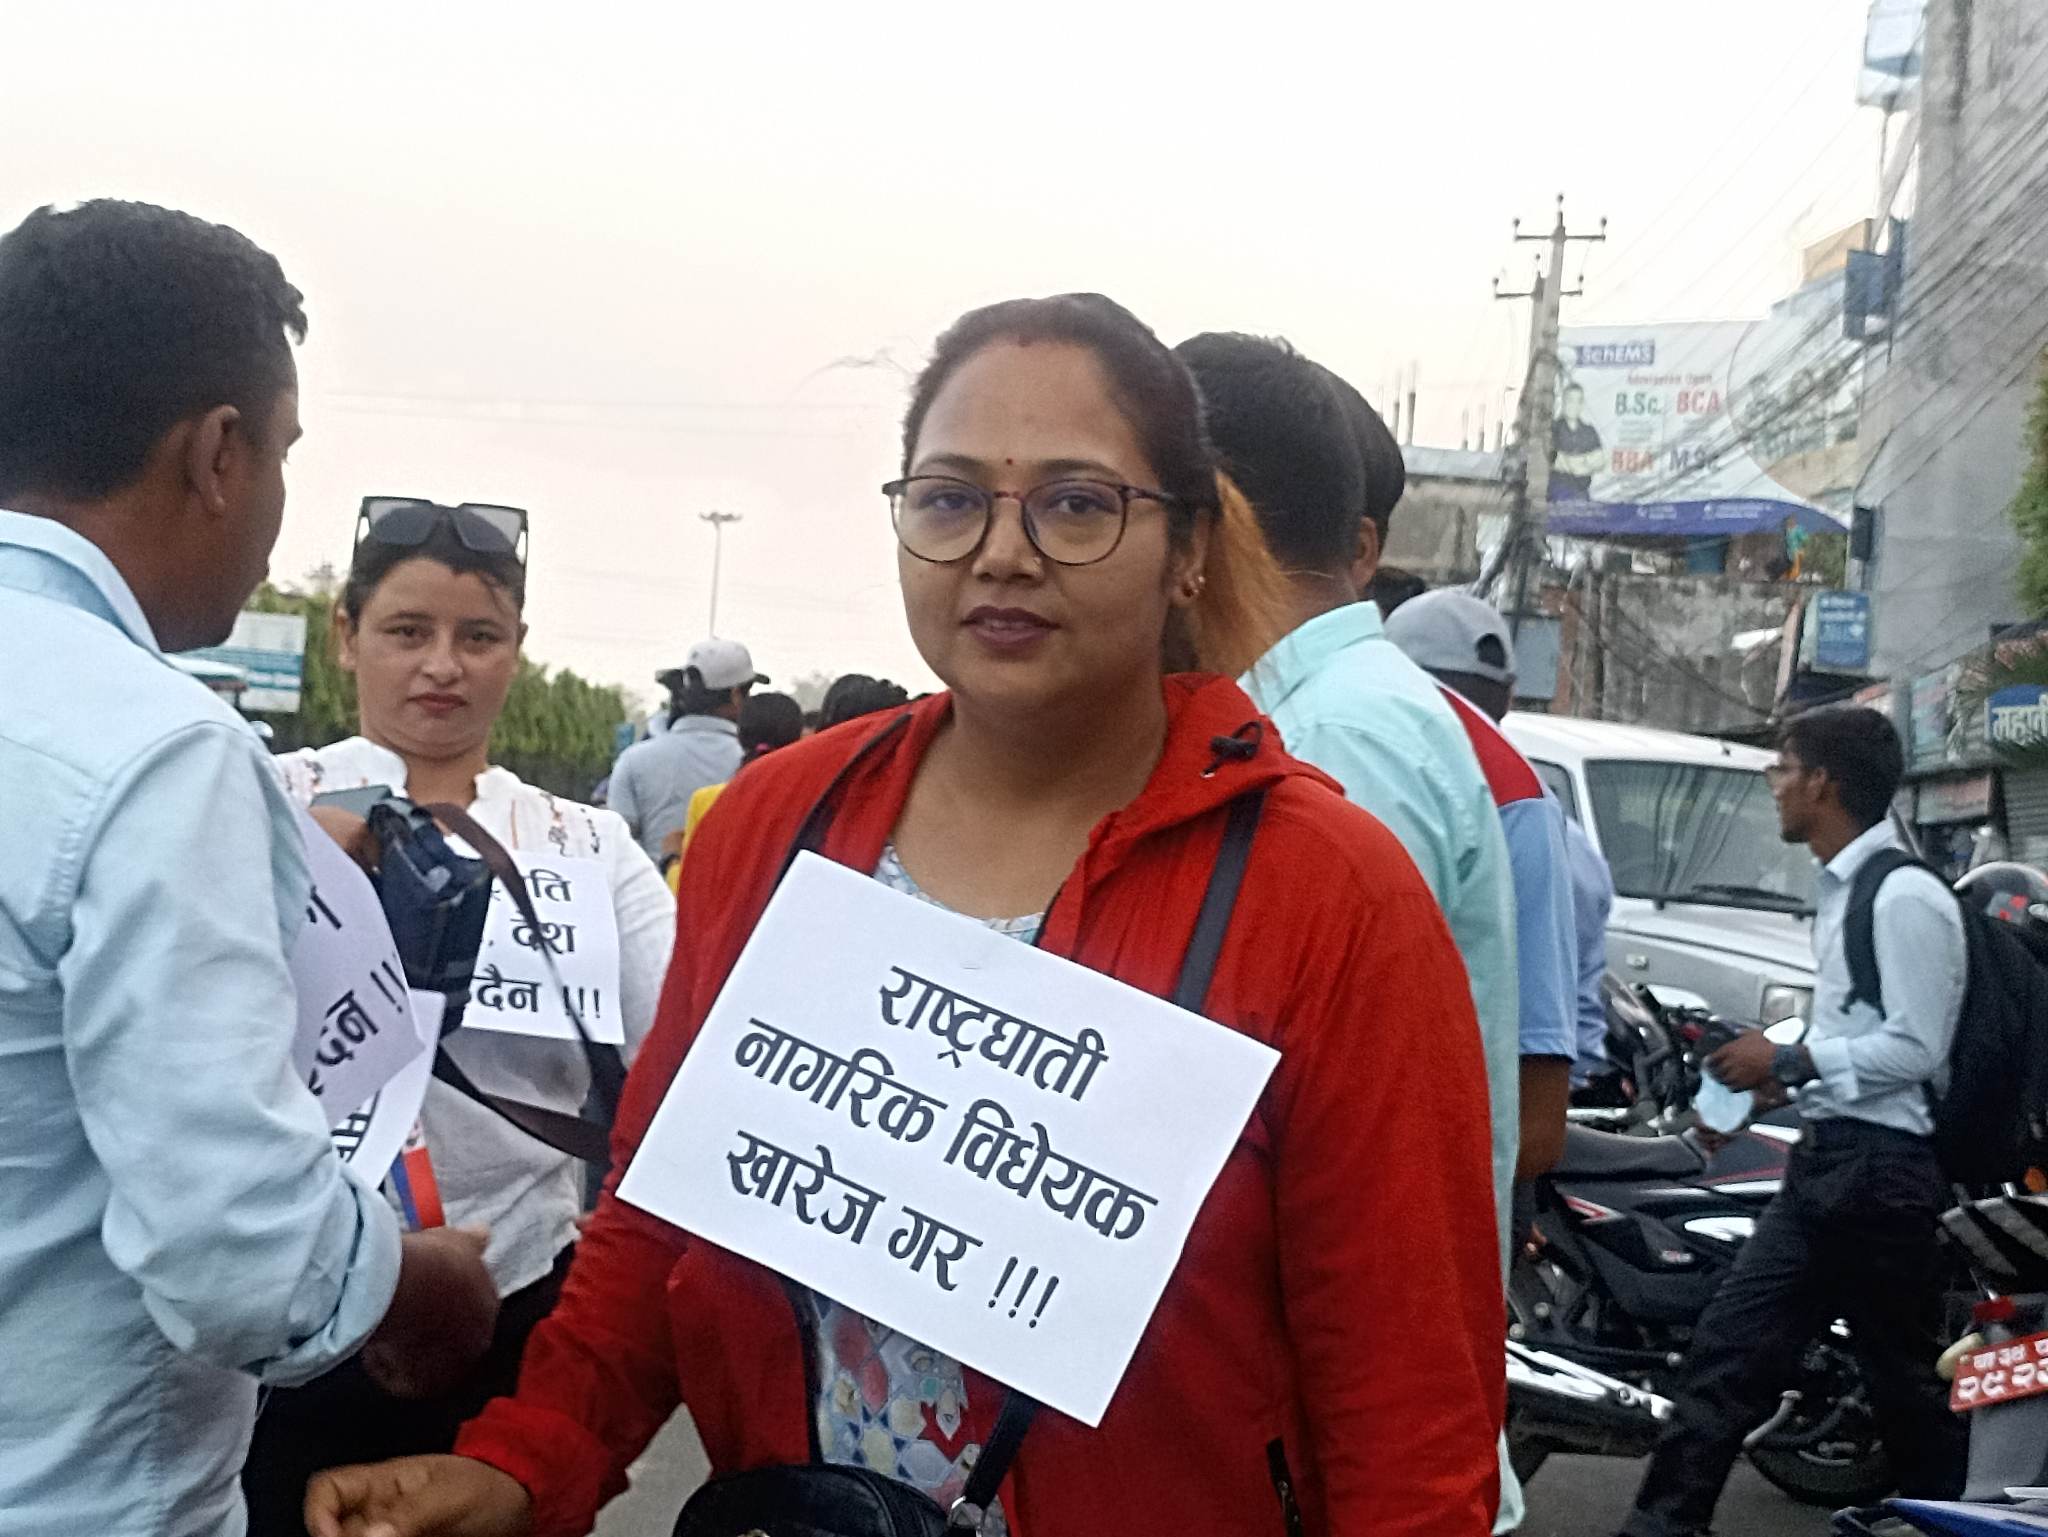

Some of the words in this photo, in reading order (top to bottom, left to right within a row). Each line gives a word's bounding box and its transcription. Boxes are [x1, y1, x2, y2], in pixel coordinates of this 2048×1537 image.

[1675, 389, 1720, 415] BCA
[878, 964, 1109, 1102] राष्ट्रघाती
[734, 1016, 947, 1144] नागरिक
[943, 1098, 1159, 1241] विधेयक
[726, 1130, 887, 1245] खारेज
[887, 1205, 983, 1292] गर
[987, 1255, 1060, 1330] !!!
